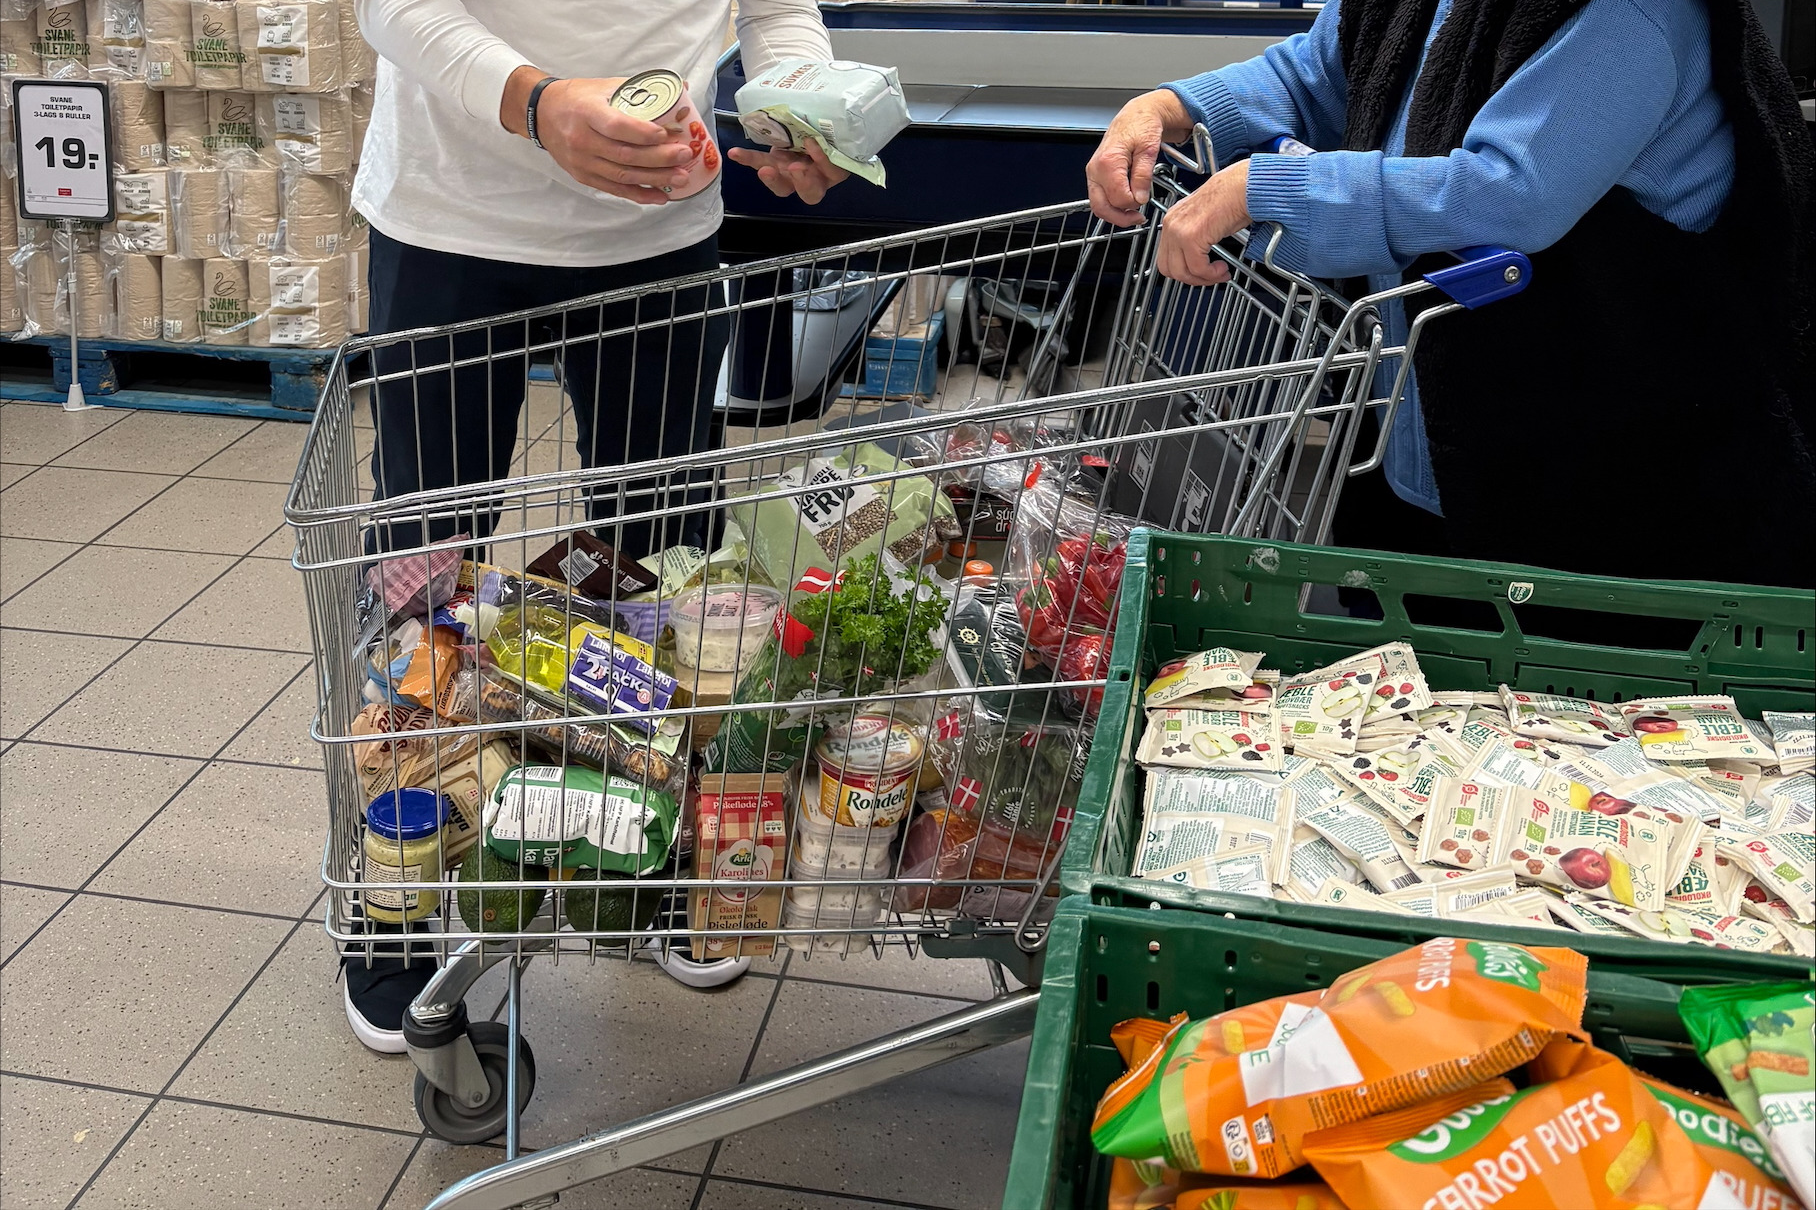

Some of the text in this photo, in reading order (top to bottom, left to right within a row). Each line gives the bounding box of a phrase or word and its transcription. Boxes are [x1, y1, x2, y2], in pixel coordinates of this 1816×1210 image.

[44, 29, 76, 42] SVANE
[30, 42, 91, 56] TOILETPAPIR
[196, 38, 228, 52] SVANE
[184, 50, 248, 64] TOILETPAPIR
[778, 64, 816, 88] SUKKER
[50, 96, 73, 104] SVANE
[41, 104, 83, 112] TOILETPAPIR
[218, 122, 252, 136] SVANE
[209, 297, 240, 311] SVANE
[1534, 1091, 1624, 1166] PUFFS
